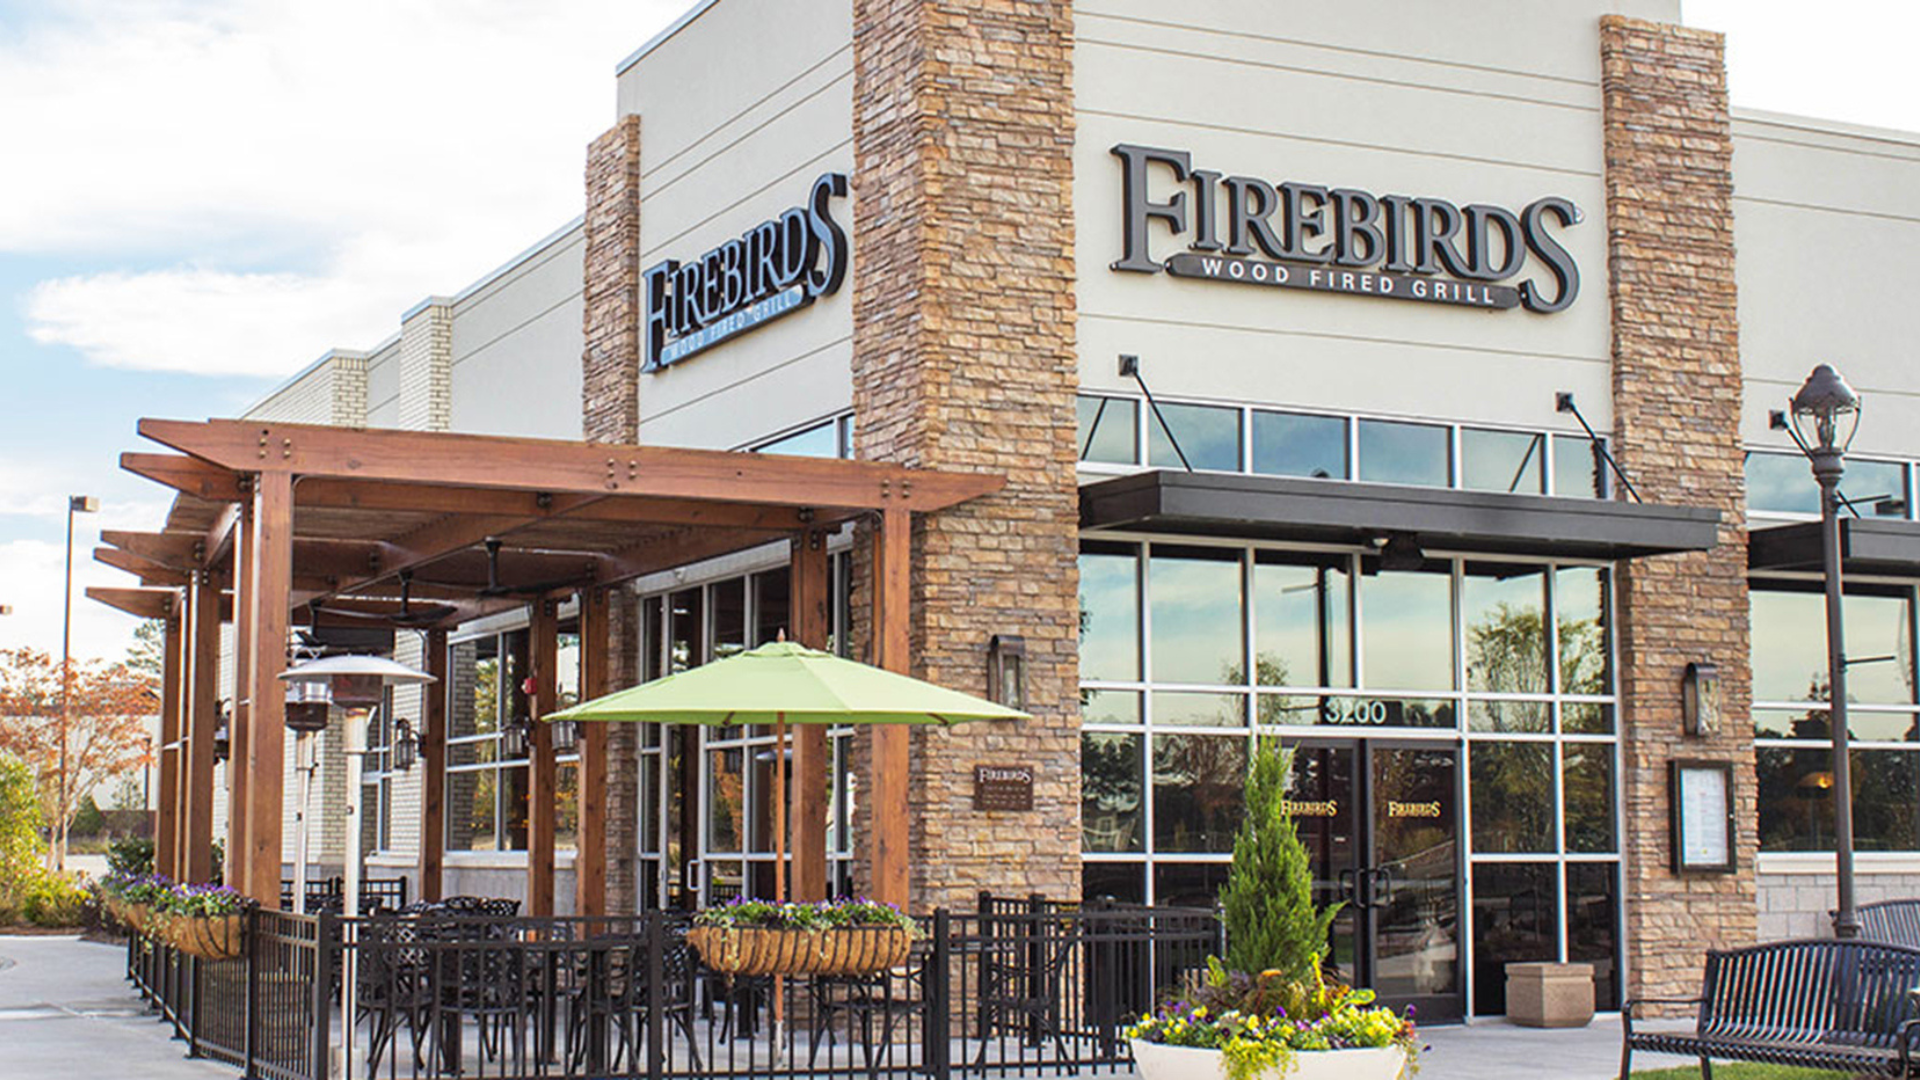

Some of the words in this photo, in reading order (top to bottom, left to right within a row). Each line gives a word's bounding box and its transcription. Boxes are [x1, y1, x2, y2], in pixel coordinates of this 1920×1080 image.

[640, 172, 848, 374] FIREBIRDS
[1109, 143, 1582, 314] FIREBIRDS
[1202, 258, 1289, 283] WOOD
[1310, 270, 1394, 293] FIRED
[1412, 280, 1494, 304] GRILL
[1325, 701, 1387, 724] 3200
